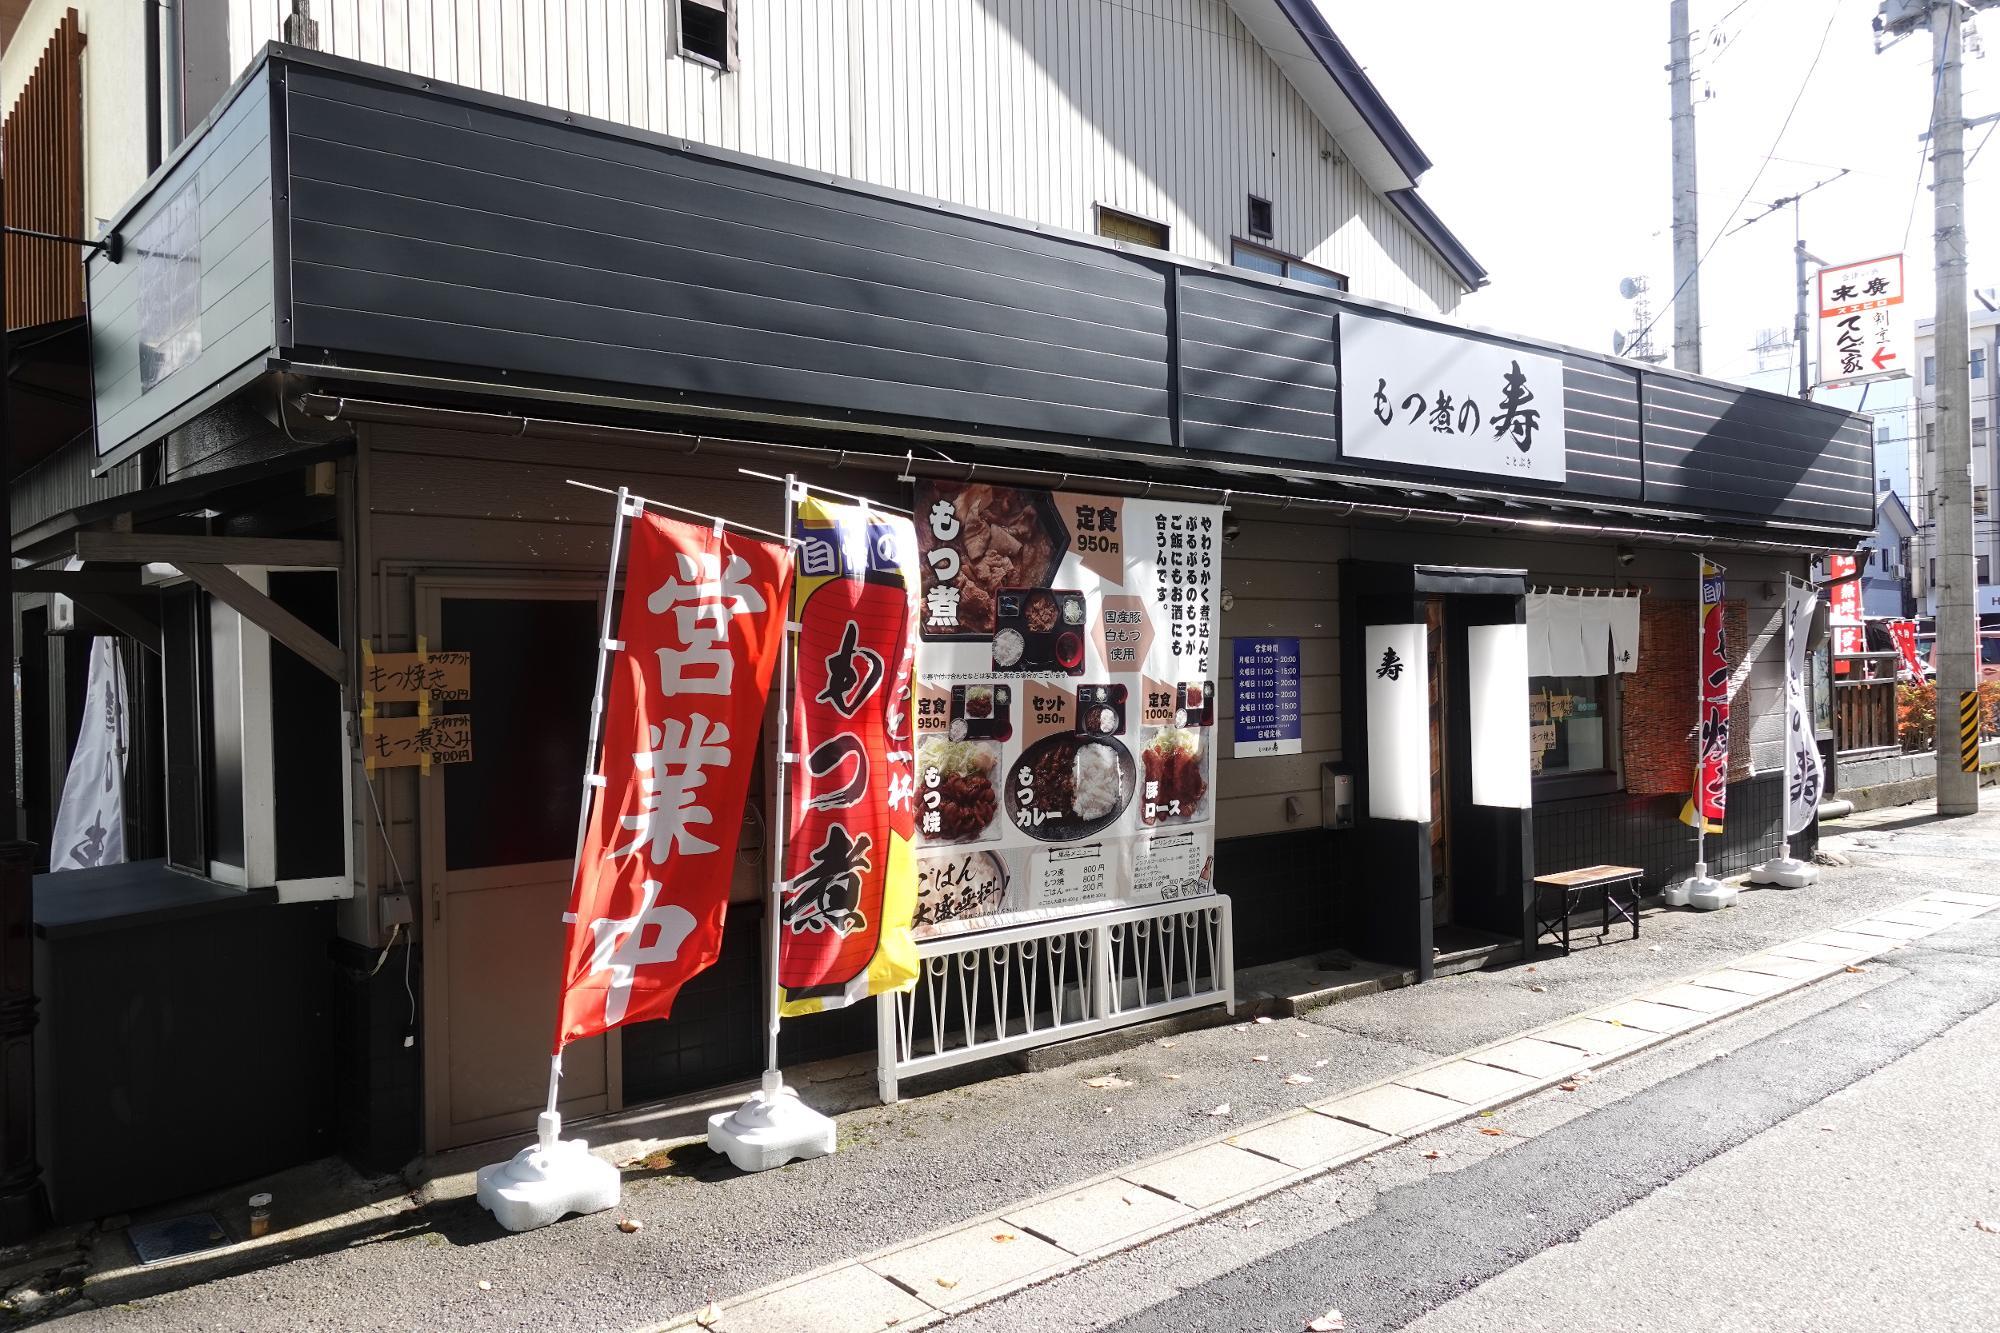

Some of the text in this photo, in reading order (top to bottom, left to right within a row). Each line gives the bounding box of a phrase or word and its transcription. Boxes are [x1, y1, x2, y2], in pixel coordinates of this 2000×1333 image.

[1831, 277, 1890, 301] 末廣
[1838, 300, 1887, 314] スエヒロ
[1873, 310, 1890, 344] 割烹
[1837, 315, 1864, 374] てんぐ家
[1374, 360, 1541, 453] もつ煮の寿
[1076, 504, 1117, 533] 定食
[1077, 534, 1119, 553] 950円
[802, 533, 898, 574] 自の
[926, 499, 961, 627] もつ煮
[1155, 513, 1168, 610] 合うんです。
[1170, 514, 1183, 656] ご飯にもお酒にも
[1186, 516, 1198, 656] ぷるぷるのもつが
[1198, 516, 1212, 673] やわらかく煮込んだ
[1105, 610, 1142, 624] 国産豚
[1105, 628, 1141, 642] 白もつ
[1110, 648, 1136, 661] 使用
[1254, 644, 1279, 653] 営業時間
[428, 654, 469, 665] テイクアウト
[1376, 646, 1404, 681] 寿
[369, 664, 447, 692] もつ焼き
[431, 688, 469, 700] 800円
[1032, 695, 1066, 711] セット
[1148, 692, 1171, 707] 定食
[918, 697, 946, 715] 定食
[1145, 709, 1173, 720] 1000円
[432, 716, 470, 730] テイクアウト
[918, 717, 946, 729] 950円
[1036, 713, 1065, 724] 950円
[375, 728, 469, 758] もつ煮込み
[432, 750, 469, 764] 800円
[782, 619, 885, 936] もつ煮
[589, 551, 766, 1027] 営業中
[1145, 781, 1159, 799] 豚
[923, 766, 941, 833] もつ焼
[1145, 799, 1181, 818] ロース
[1016, 807, 1062, 827] カレー
[918, 856, 978, 897] ごはん
[1083, 863, 1105, 874] 800円
[1044, 888, 1063, 898] ごはん
[1082, 882, 1104, 892] 200円
